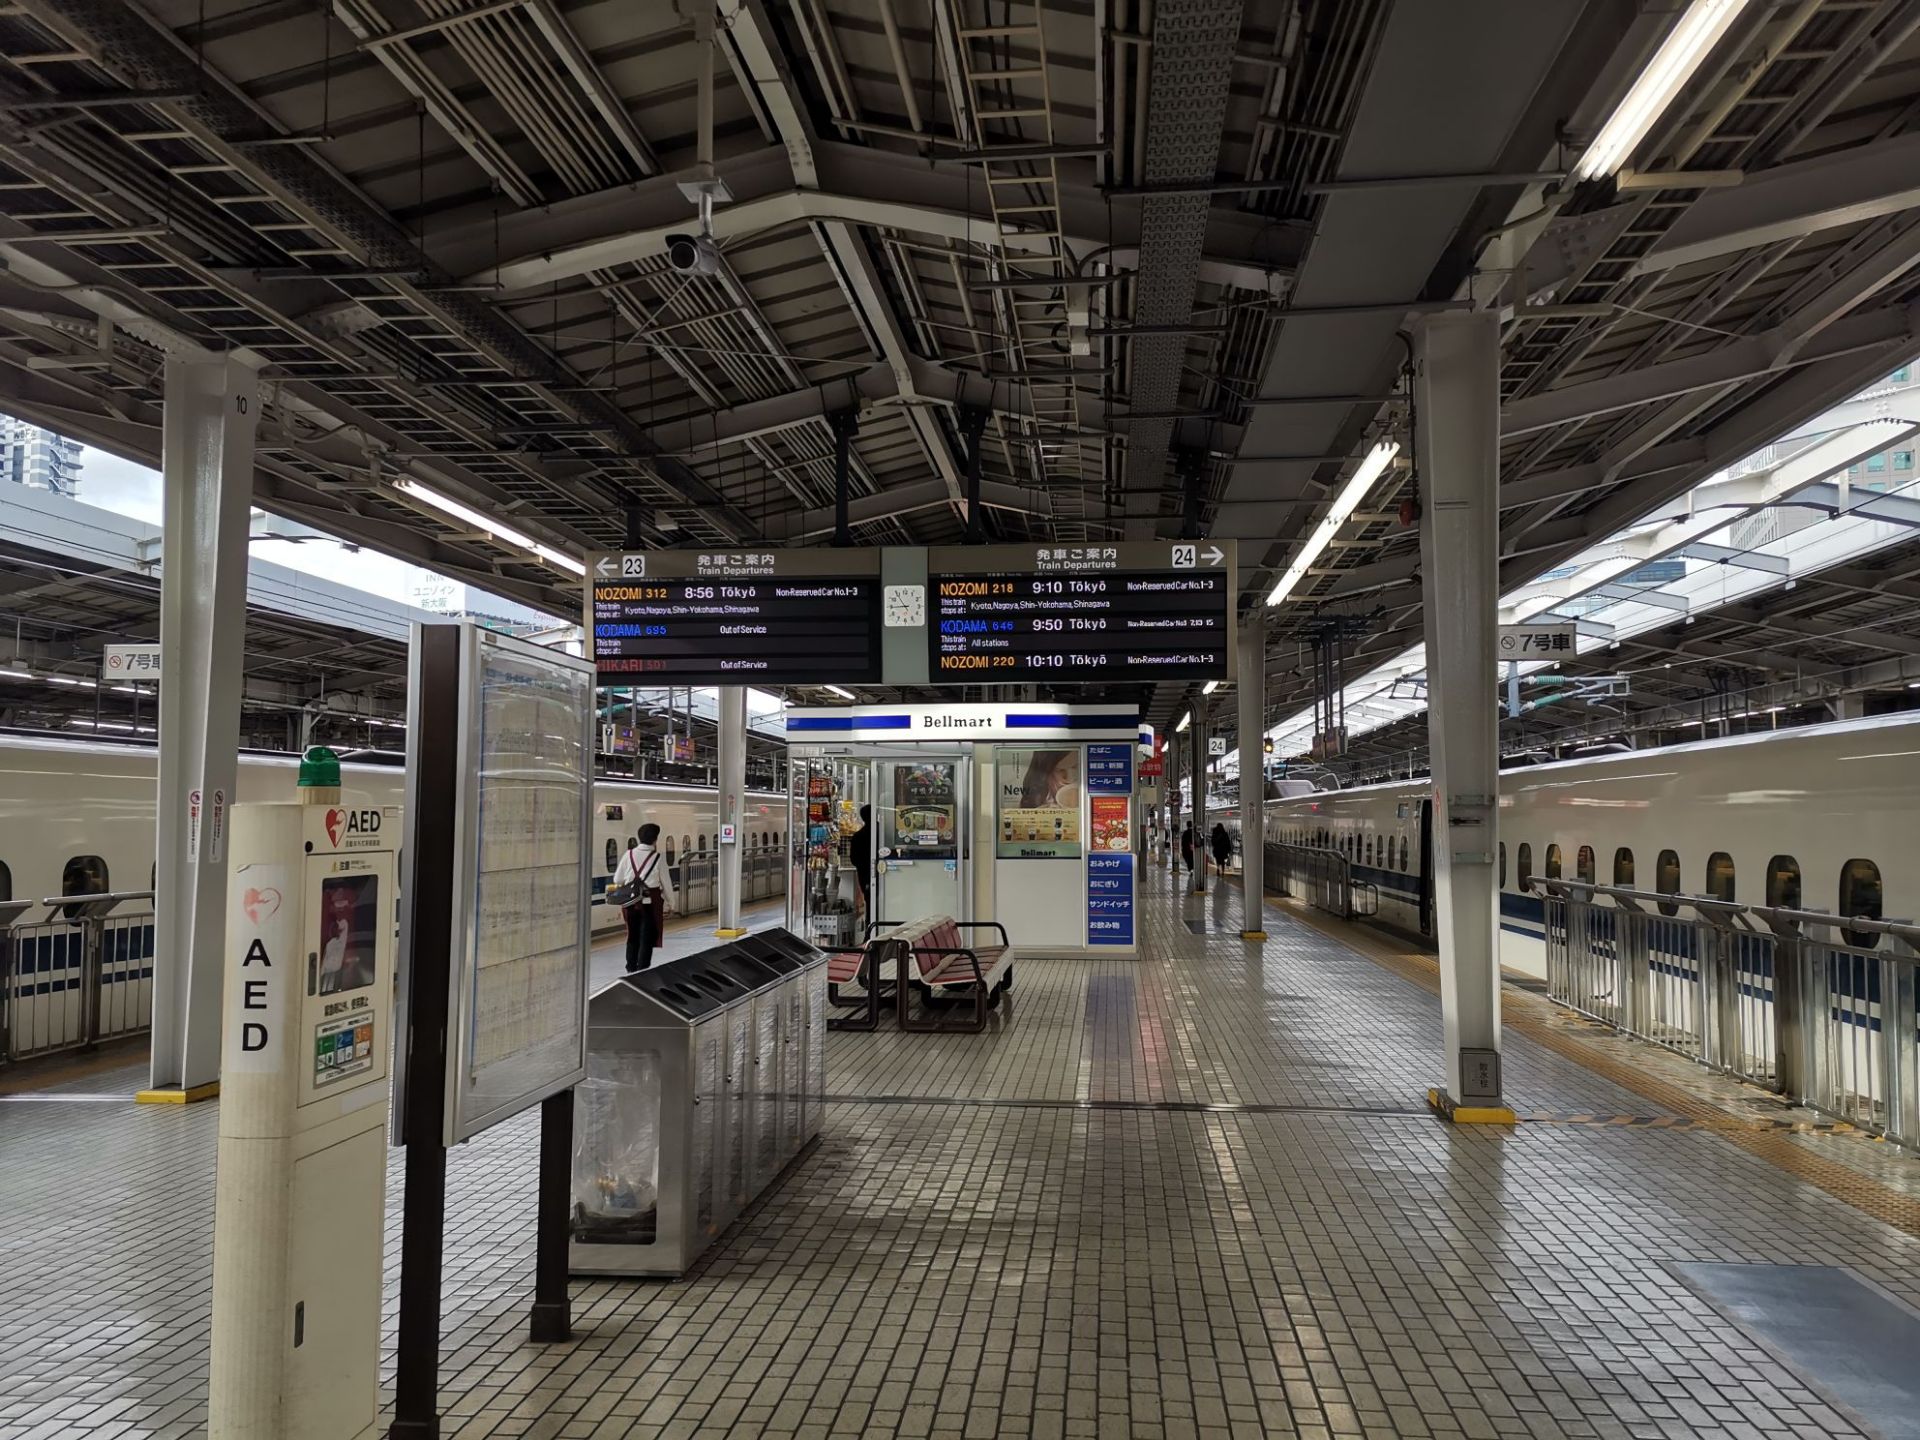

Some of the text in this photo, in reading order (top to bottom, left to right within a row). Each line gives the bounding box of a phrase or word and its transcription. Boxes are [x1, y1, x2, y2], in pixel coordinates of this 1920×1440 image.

[235, 393, 248, 415] 10
[697, 554, 775, 566] 発車ご案内
[1037, 548, 1117, 560] 発車ご案内
[1174, 548, 1194, 565] 24
[624, 557, 643, 575] 23
[697, 566, 774, 576] Train Departures
[1037, 559, 1117, 571] Train Departures
[595, 587, 642, 601] NOZOMI
[646, 588, 667, 598] 312
[684, 586, 714, 599] 8:56
[720, 586, 756, 600] Tōkyō
[940, 582, 988, 596] NOZOMI
[992, 583, 1014, 593] 218
[1032, 581, 1062, 594] 9:10
[1069, 580, 1106, 593] Tōkyō
[421, 598, 448, 608] 新大阪
[595, 624, 642, 636] KODAMA
[720, 625, 732, 634] Out
[741, 625, 767, 635] Service
[940, 620, 987, 633] KODAMA
[1032, 618, 1062, 631] 9:50
[1069, 618, 1106, 630] Tōkyō
[981, 639, 1009, 647] stations
[1519, 632, 1571, 652] 7号車
[596, 660, 643, 672] HIKARI
[721, 661, 732, 669] Out
[741, 661, 767, 669] Service
[941, 656, 988, 669] NOZOMI
[993, 656, 1015, 666] 220
[1025, 655, 1063, 667] 10:10
[1069, 655, 1107, 667] Tōkyō
[924, 715, 992, 728] Bellmart
[1211, 740, 1223, 751] 24
[1089, 777, 1122, 785] ビール・酒
[1004, 785, 1030, 796] New
[347, 810, 381, 833] AED
[1089, 860, 1120, 868] おみやげ
[1089, 880, 1119, 888] おにぎり
[1089, 900, 1130, 908] サンドイッチ
[1089, 921, 1120, 929] お飲み物
[241, 938, 272, 1052] AED
